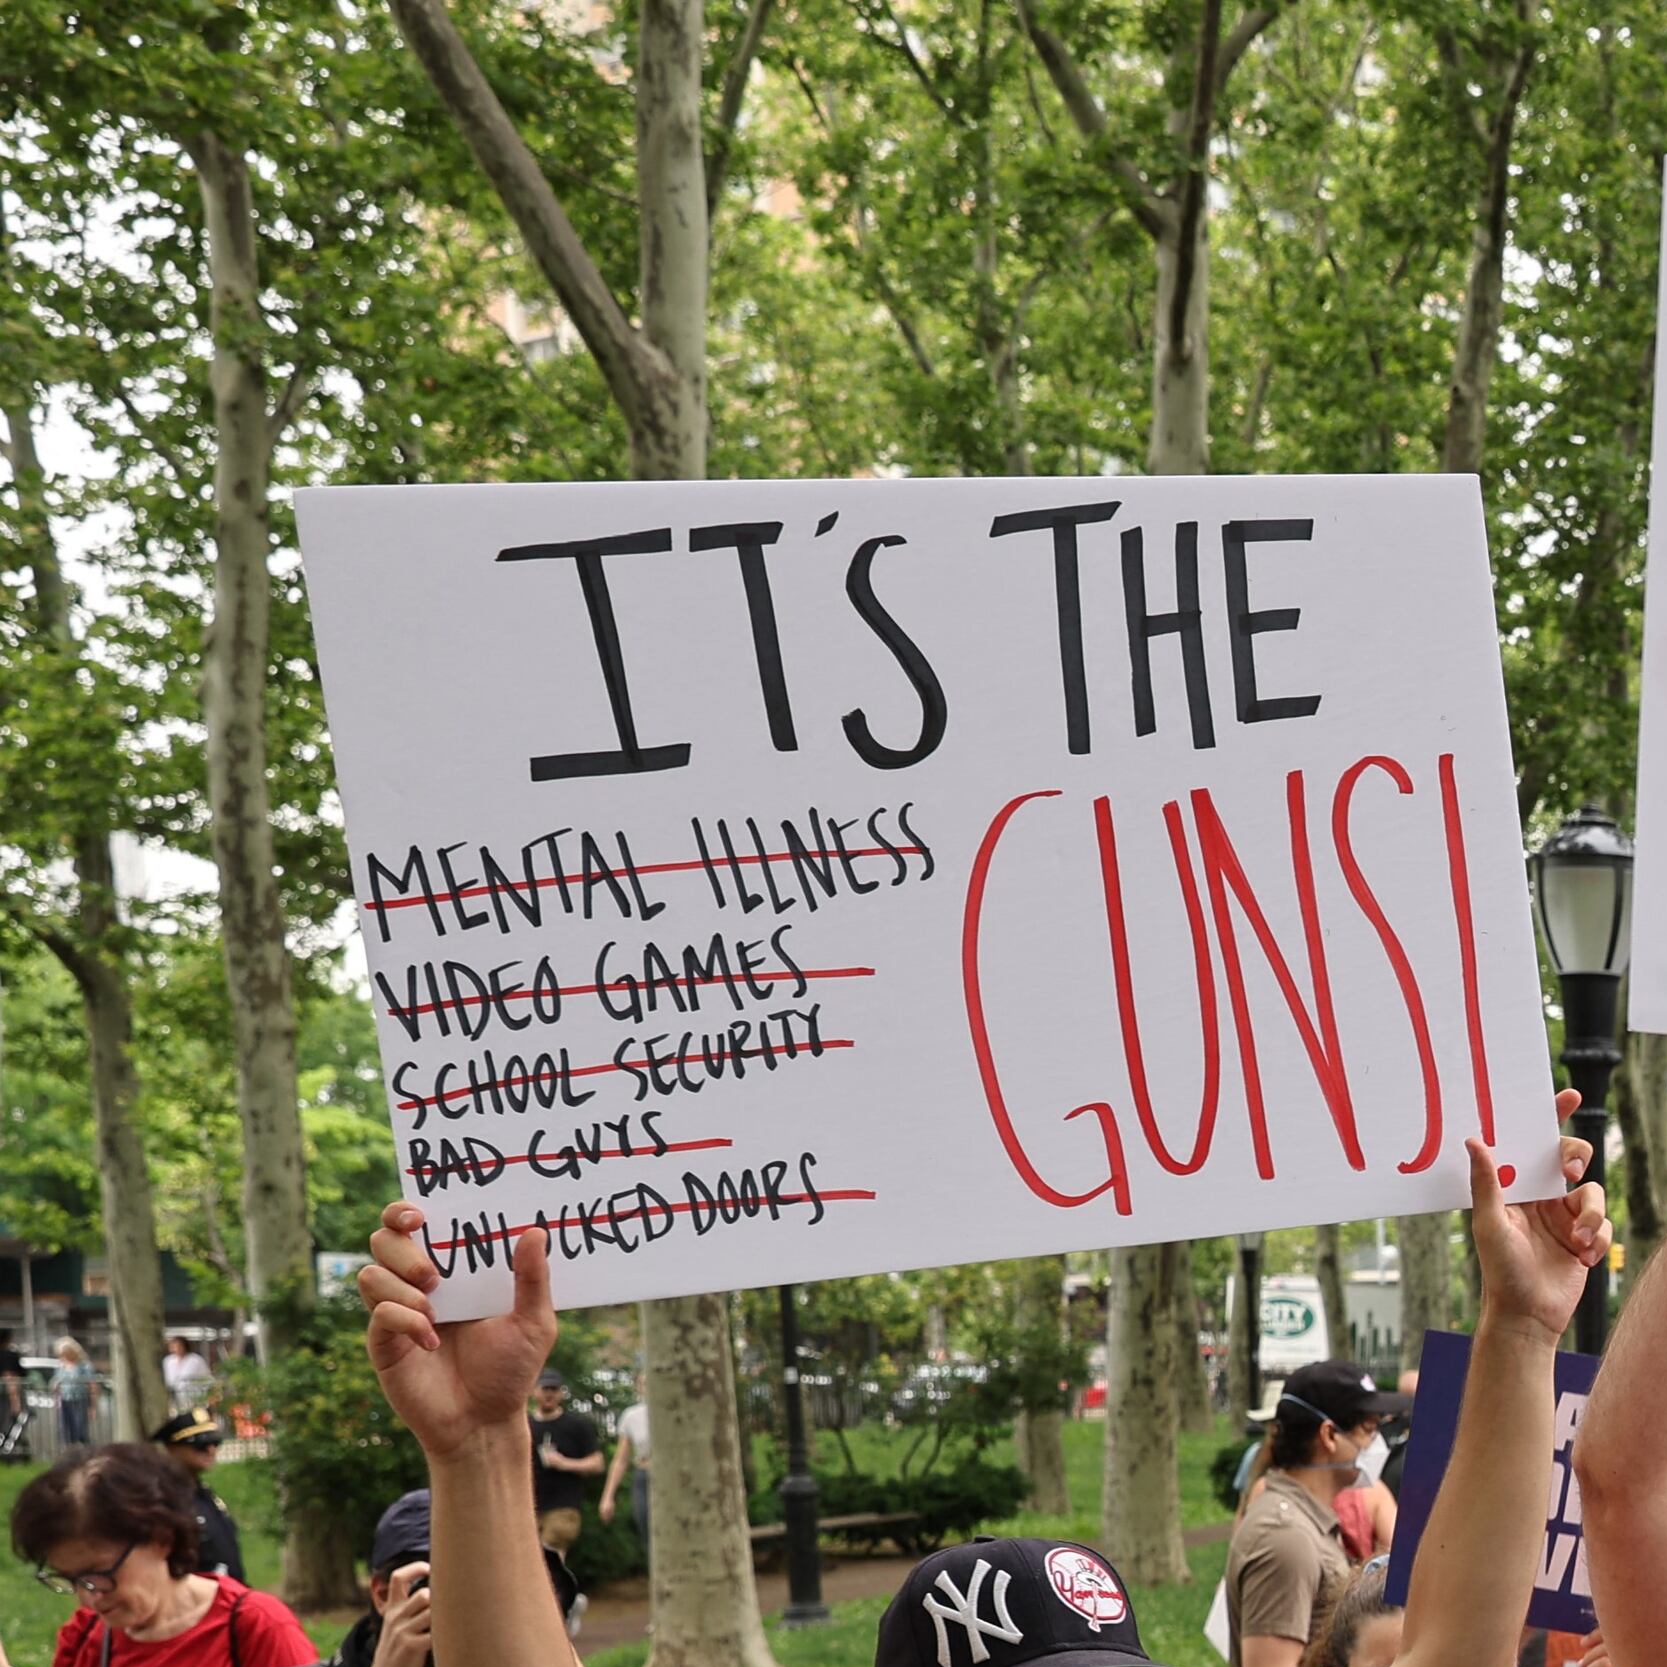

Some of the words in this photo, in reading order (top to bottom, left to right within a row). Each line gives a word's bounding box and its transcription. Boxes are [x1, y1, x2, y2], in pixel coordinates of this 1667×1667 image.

[496, 510, 947, 780] IT'S
[990, 500, 1321, 754] THE
[366, 828, 667, 942] MENTAL
[691, 802, 935, 915] ILLNESS
[374, 955, 562, 1042] VIDEO
[594, 924, 808, 1024] GAMES
[962, 754, 1518, 1217] GUNS!
[392, 1047, 597, 1130] SCHOOL
[612, 1003, 825, 1101] SECURITY
[407, 1136, 506, 1197] BAD
[527, 1111, 670, 1180] GUYS
[682, 1152, 826, 1236] DOORS
